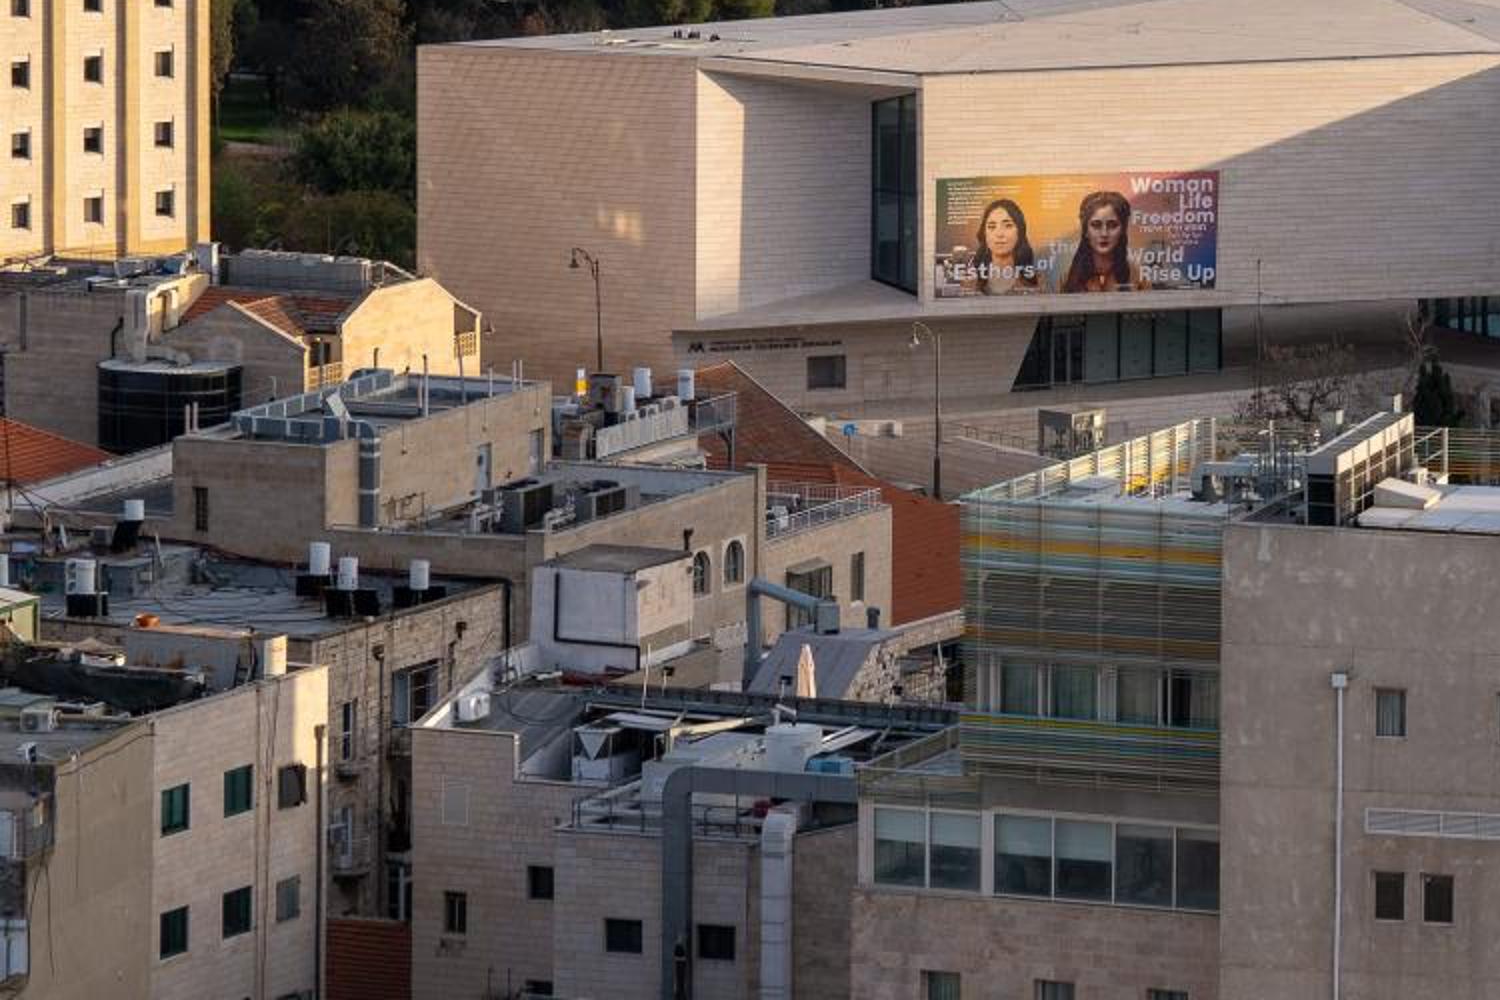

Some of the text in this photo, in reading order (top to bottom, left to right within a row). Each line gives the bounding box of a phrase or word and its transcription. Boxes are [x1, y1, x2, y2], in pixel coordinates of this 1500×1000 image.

[1131, 177, 1212, 193] Woman
[1180, 191, 1213, 208] Life
[1132, 208, 1214, 225] Freedom
[1127, 246, 1184, 264] World
[953, 256, 1055, 280] Esthers of
[1140, 264, 1214, 285] Rise Up
